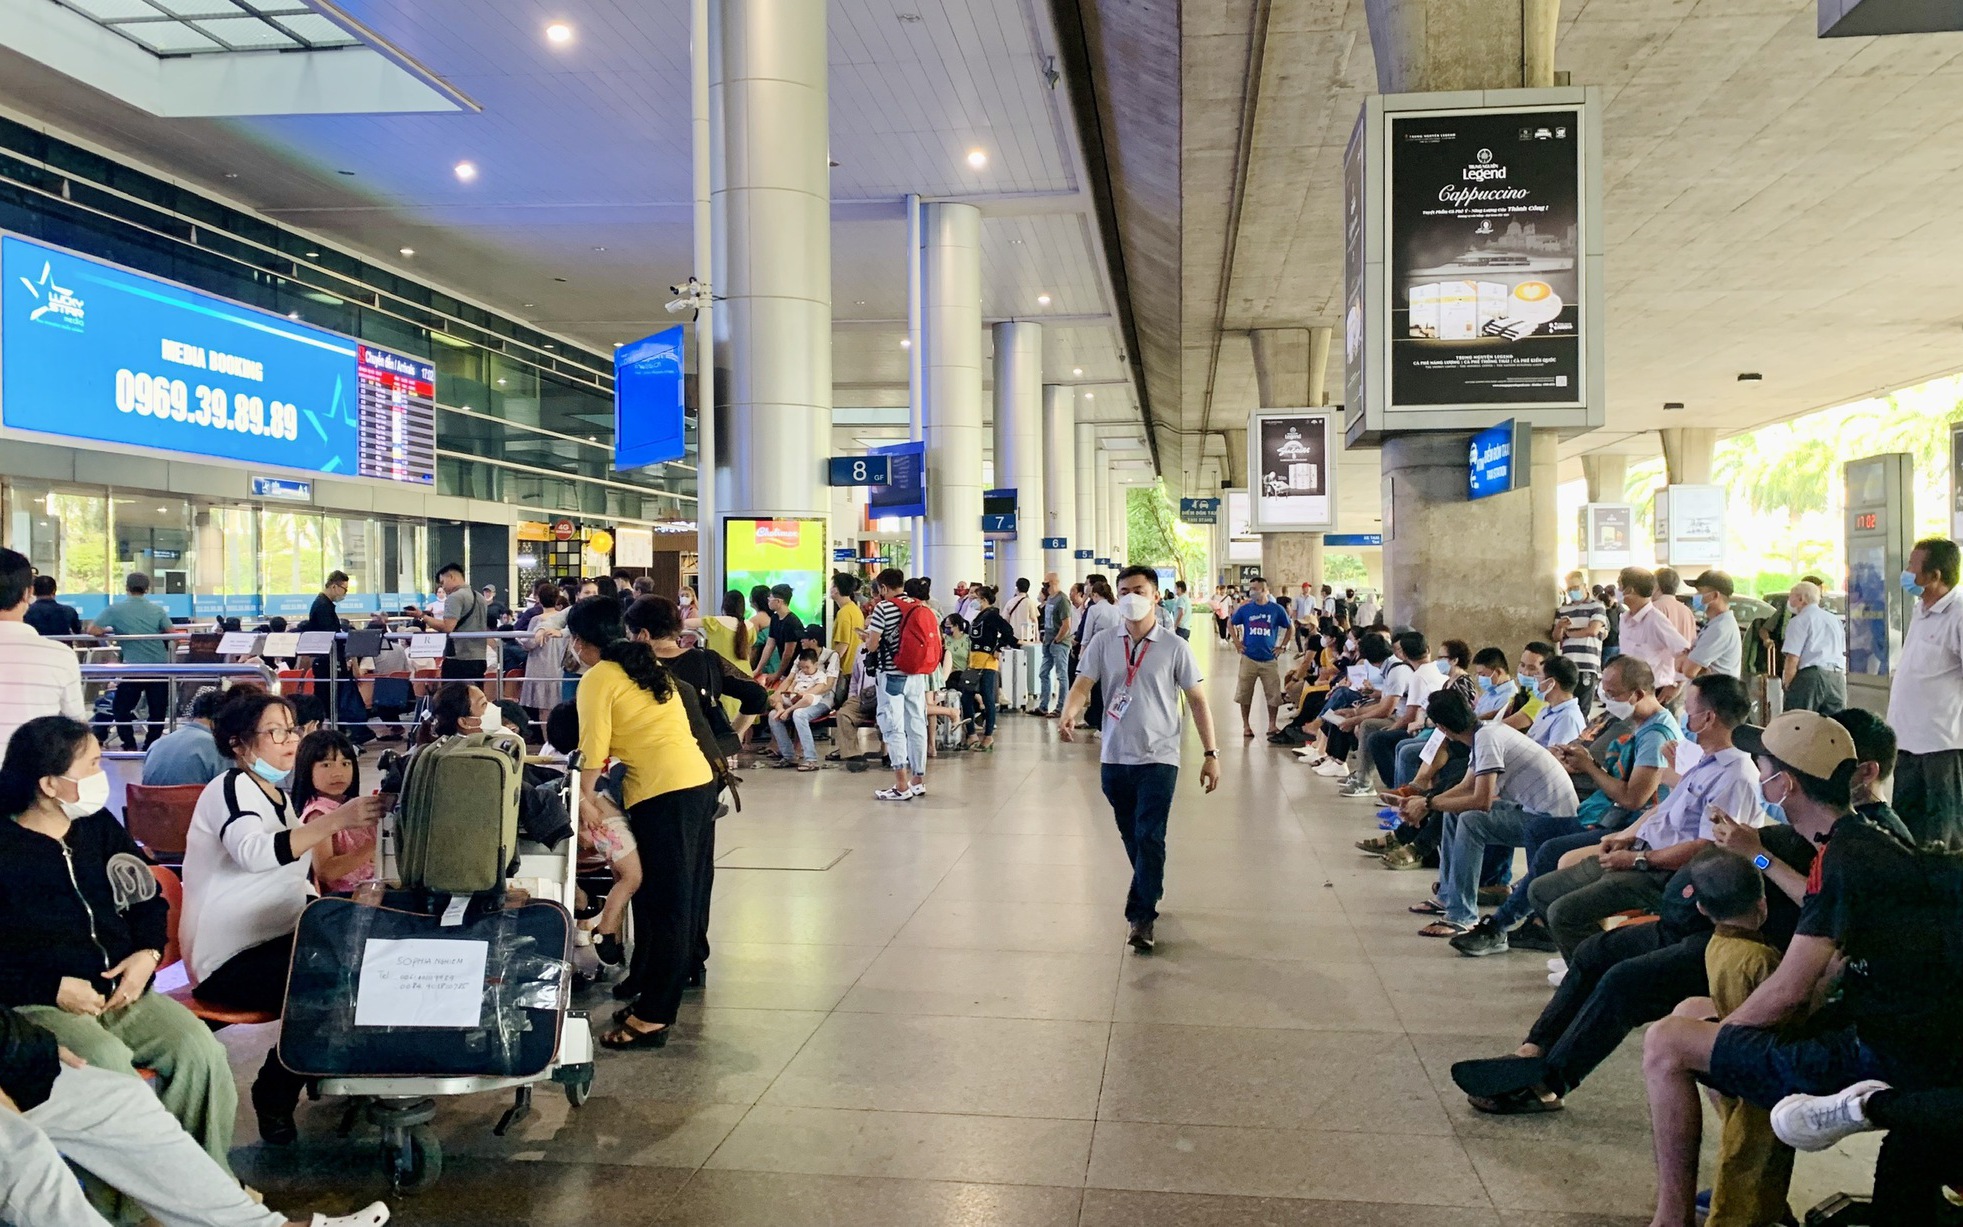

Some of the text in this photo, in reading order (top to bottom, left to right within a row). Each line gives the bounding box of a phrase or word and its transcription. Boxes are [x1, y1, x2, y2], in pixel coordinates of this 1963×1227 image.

[1463, 166, 1506, 182] Legend
[1438, 184, 1530, 207] Cappuccino
[1528, 205, 1545, 213] Công
[161, 338, 263, 382] MEDIA BOOKING
[115, 368, 298, 441] 0969.39.89.89
[853, 461, 867, 481] 8
[995, 516, 1005, 529] 7
[1052, 539, 1059, 548] 6
[1249, 627, 1271, 636] MOM
